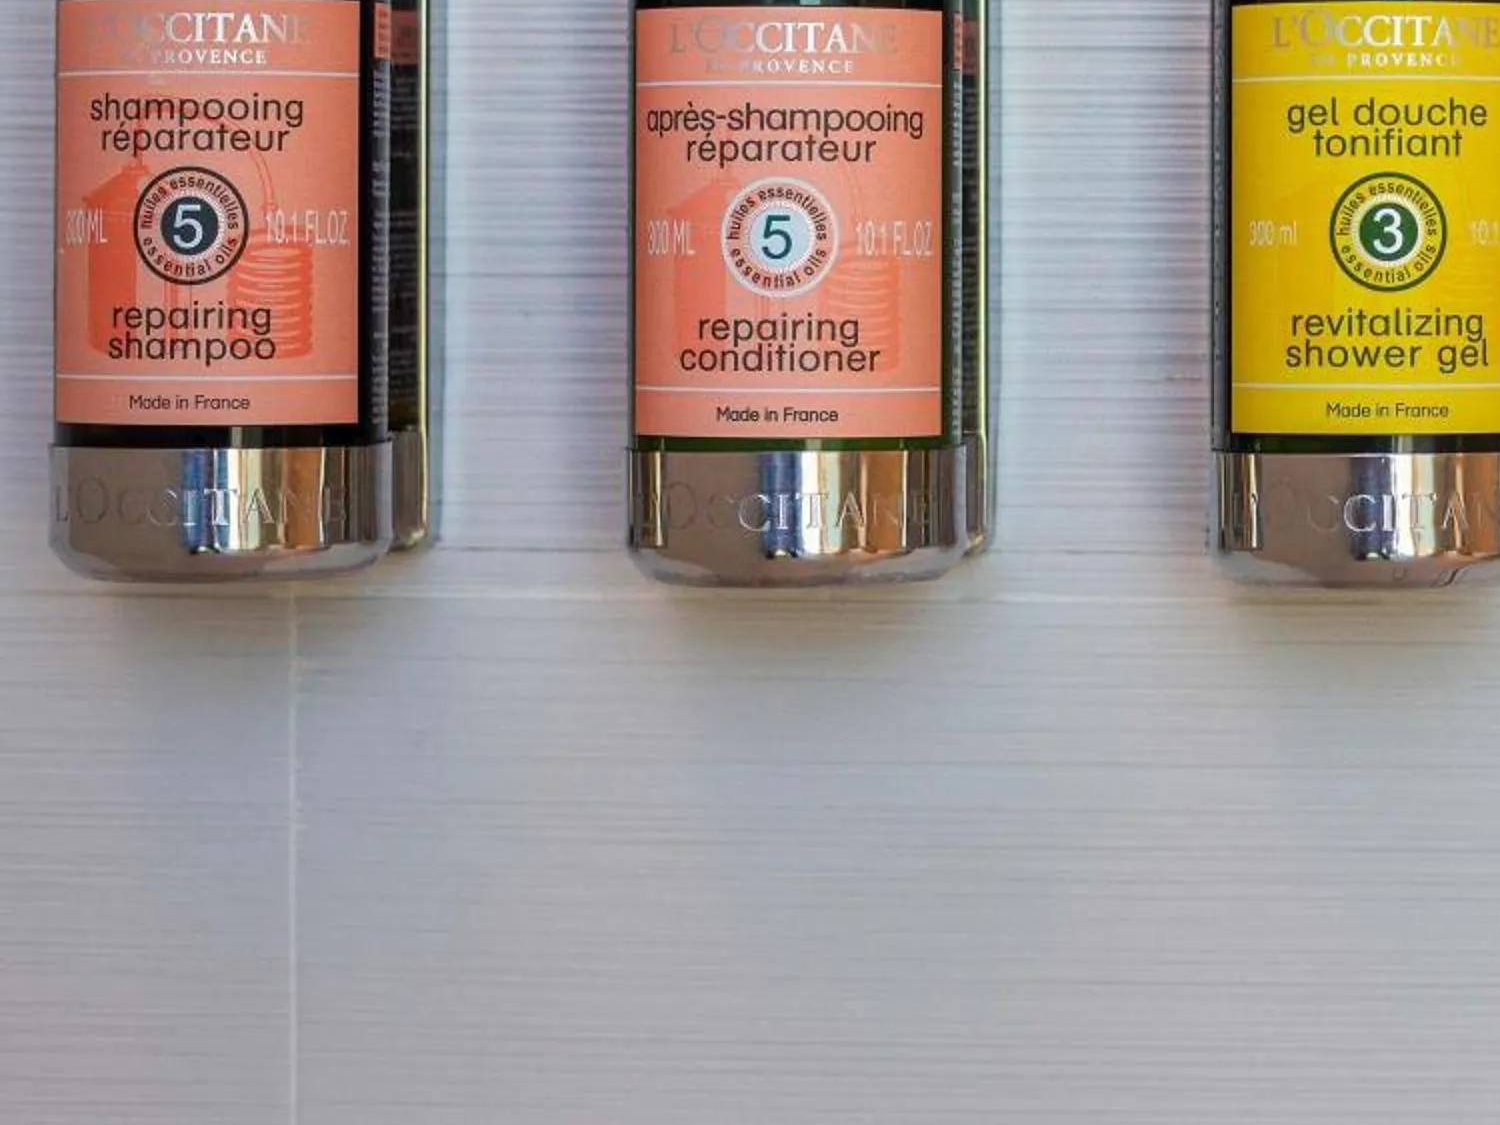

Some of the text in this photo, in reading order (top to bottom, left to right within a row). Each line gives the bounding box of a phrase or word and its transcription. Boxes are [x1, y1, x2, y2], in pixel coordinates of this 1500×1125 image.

[740, 59, 854, 74] PROVENCE
[1348, 51, 1461, 67] PROVENCE
[90, 93, 304, 128] shampooing
[647, 101, 924, 139] après-shampooing
[1287, 97, 1487, 134] gel douche
[101, 121, 290, 157] réparateur
[686, 131, 876, 168] réparateur
[1313, 128, 1462, 157] tonifiant
[172, 203, 204, 249] 5
[761, 214, 793, 260] 5
[1372, 207, 1404, 255] 3
[112, 300, 272, 336] repairing
[698, 312, 860, 348] repairing
[1291, 307, 1484, 343] revitalizing
[108, 331, 277, 367] shampoo
[679, 343, 880, 373] conditioner
[1285, 338, 1489, 374] shower gel
[129, 394, 251, 411] Made in France
[716, 406, 839, 423] Made in France
[1326, 402, 1449, 418] Made in France
